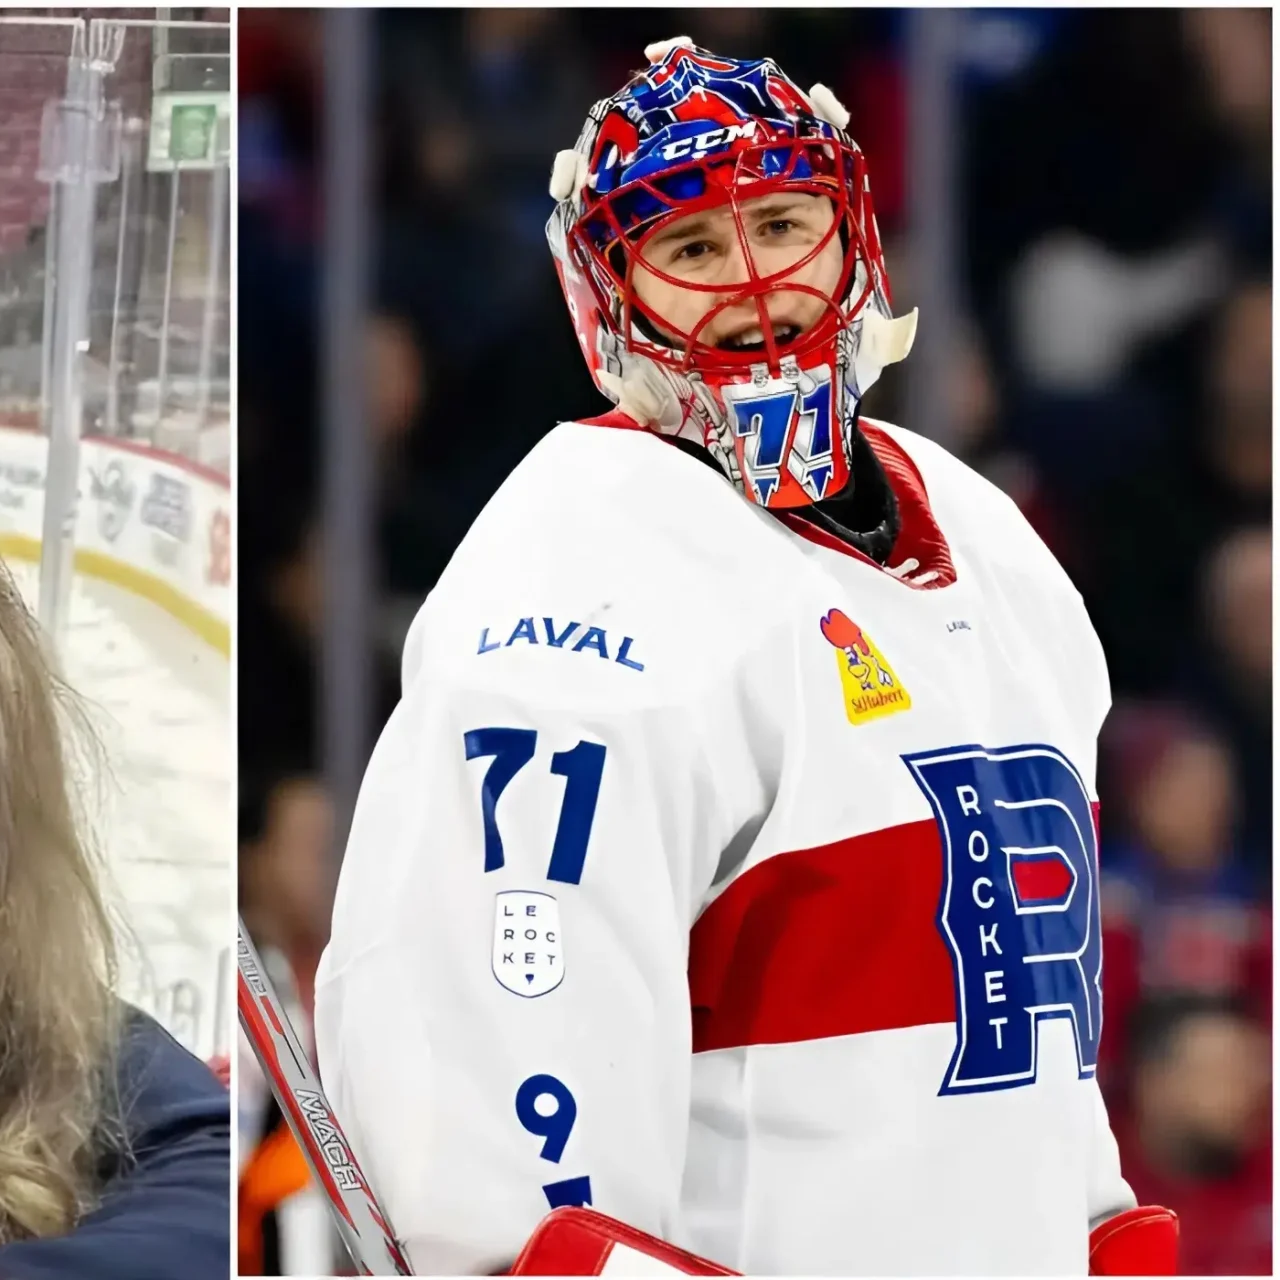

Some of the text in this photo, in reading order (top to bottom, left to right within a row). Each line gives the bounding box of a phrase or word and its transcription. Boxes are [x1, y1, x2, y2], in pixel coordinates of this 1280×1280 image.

[661, 120, 757, 161] CCM
[730, 379, 834, 507] 71
[477, 616, 645, 672] LAVAL
[463, 726, 607, 886] 71
[504, 905, 537, 917] LE
[956, 785, 1009, 1050] ROCKET
[294, 1088, 362, 1191] MACH
